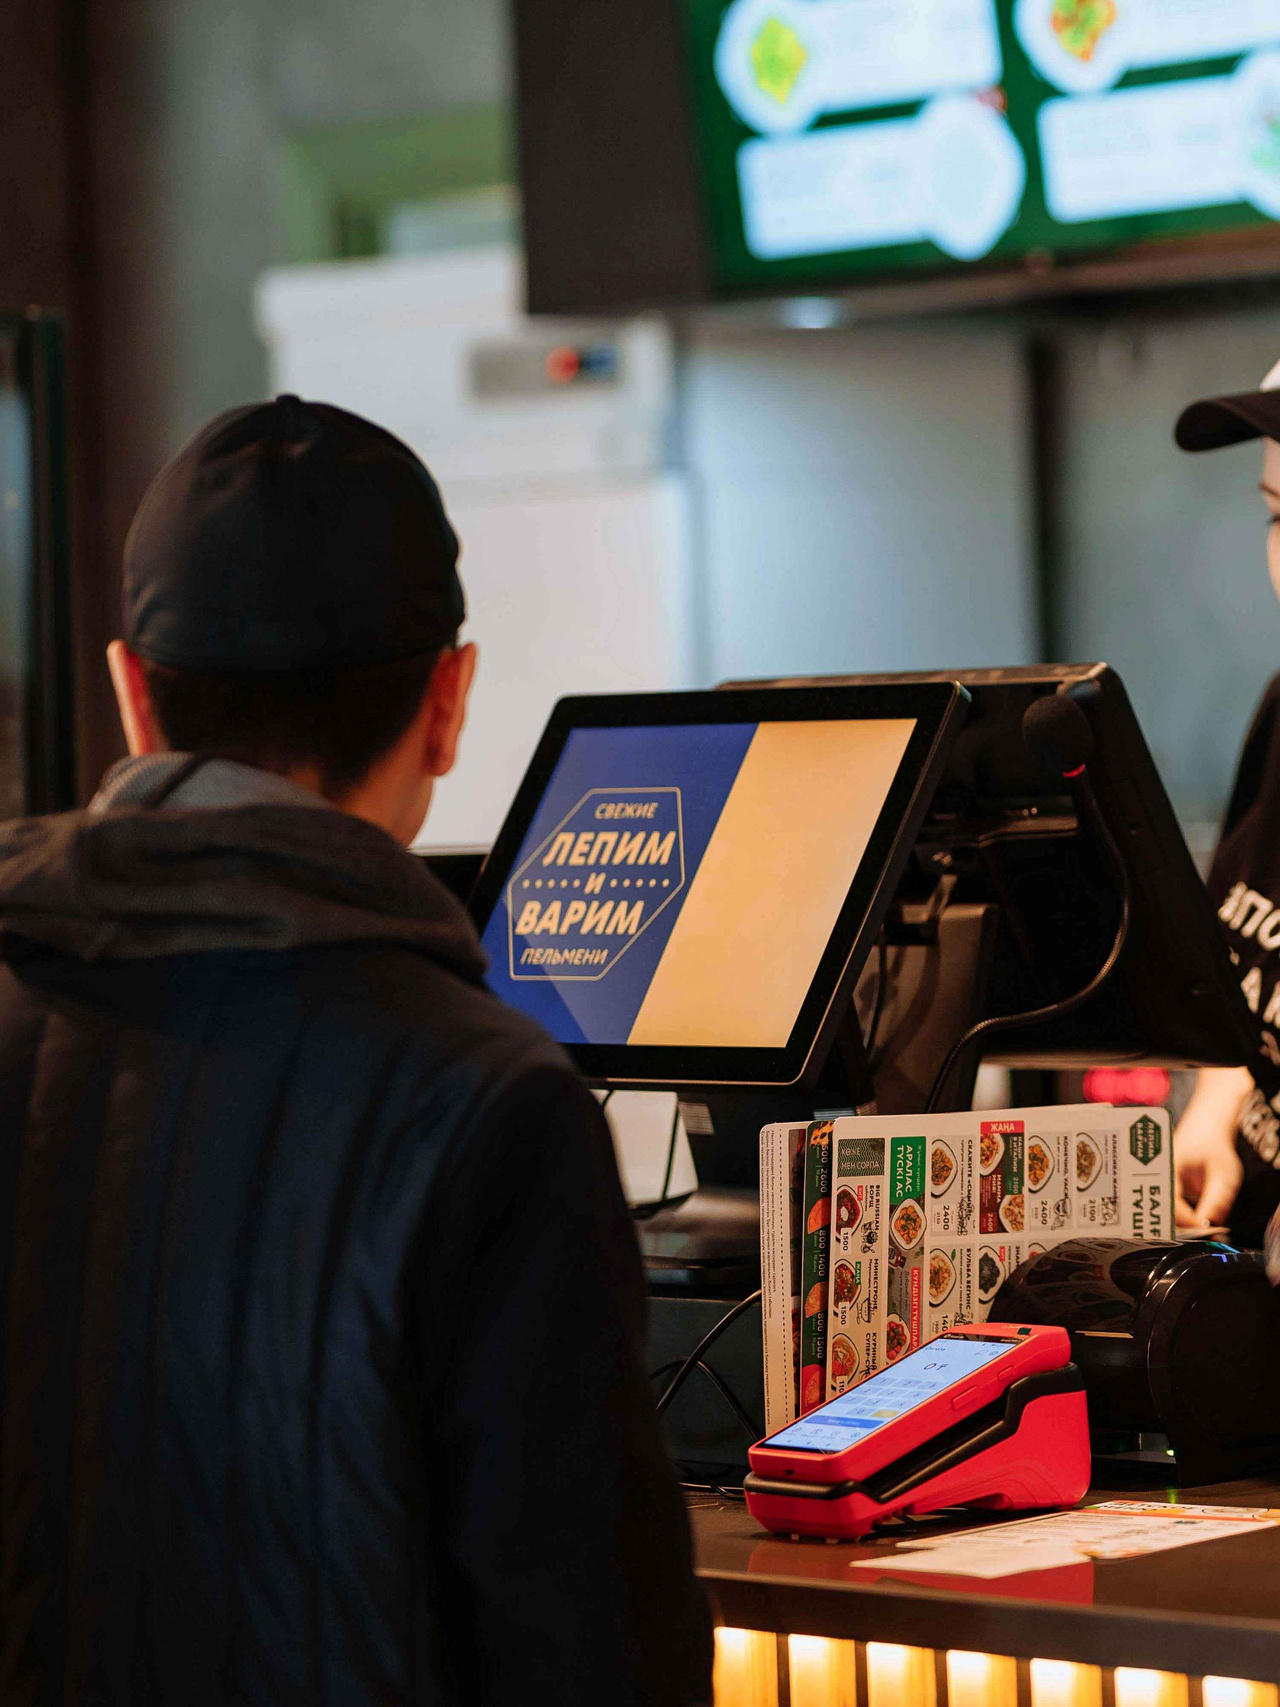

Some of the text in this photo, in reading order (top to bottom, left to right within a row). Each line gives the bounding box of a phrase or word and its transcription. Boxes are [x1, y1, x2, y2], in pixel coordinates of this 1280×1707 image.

[594, 802, 659, 820] СВЕЖИЕ
[541, 830, 677, 867] ЛЕПИМ
[583, 871, 607, 895] И
[514, 899, 645, 936] ВАРИМ
[519, 947, 609, 966] ПЕЛЬМЕНИ
[820, 1168, 828, 1193] 2600
[905, 1144, 913, 1193] АРАЛАС
[896, 1181, 903, 1198] АС
[1149, 1185, 1161, 1238] БАЛҒ
[818, 1253, 826, 1277] 1400
[816, 1312, 825, 1359] 800 1500
